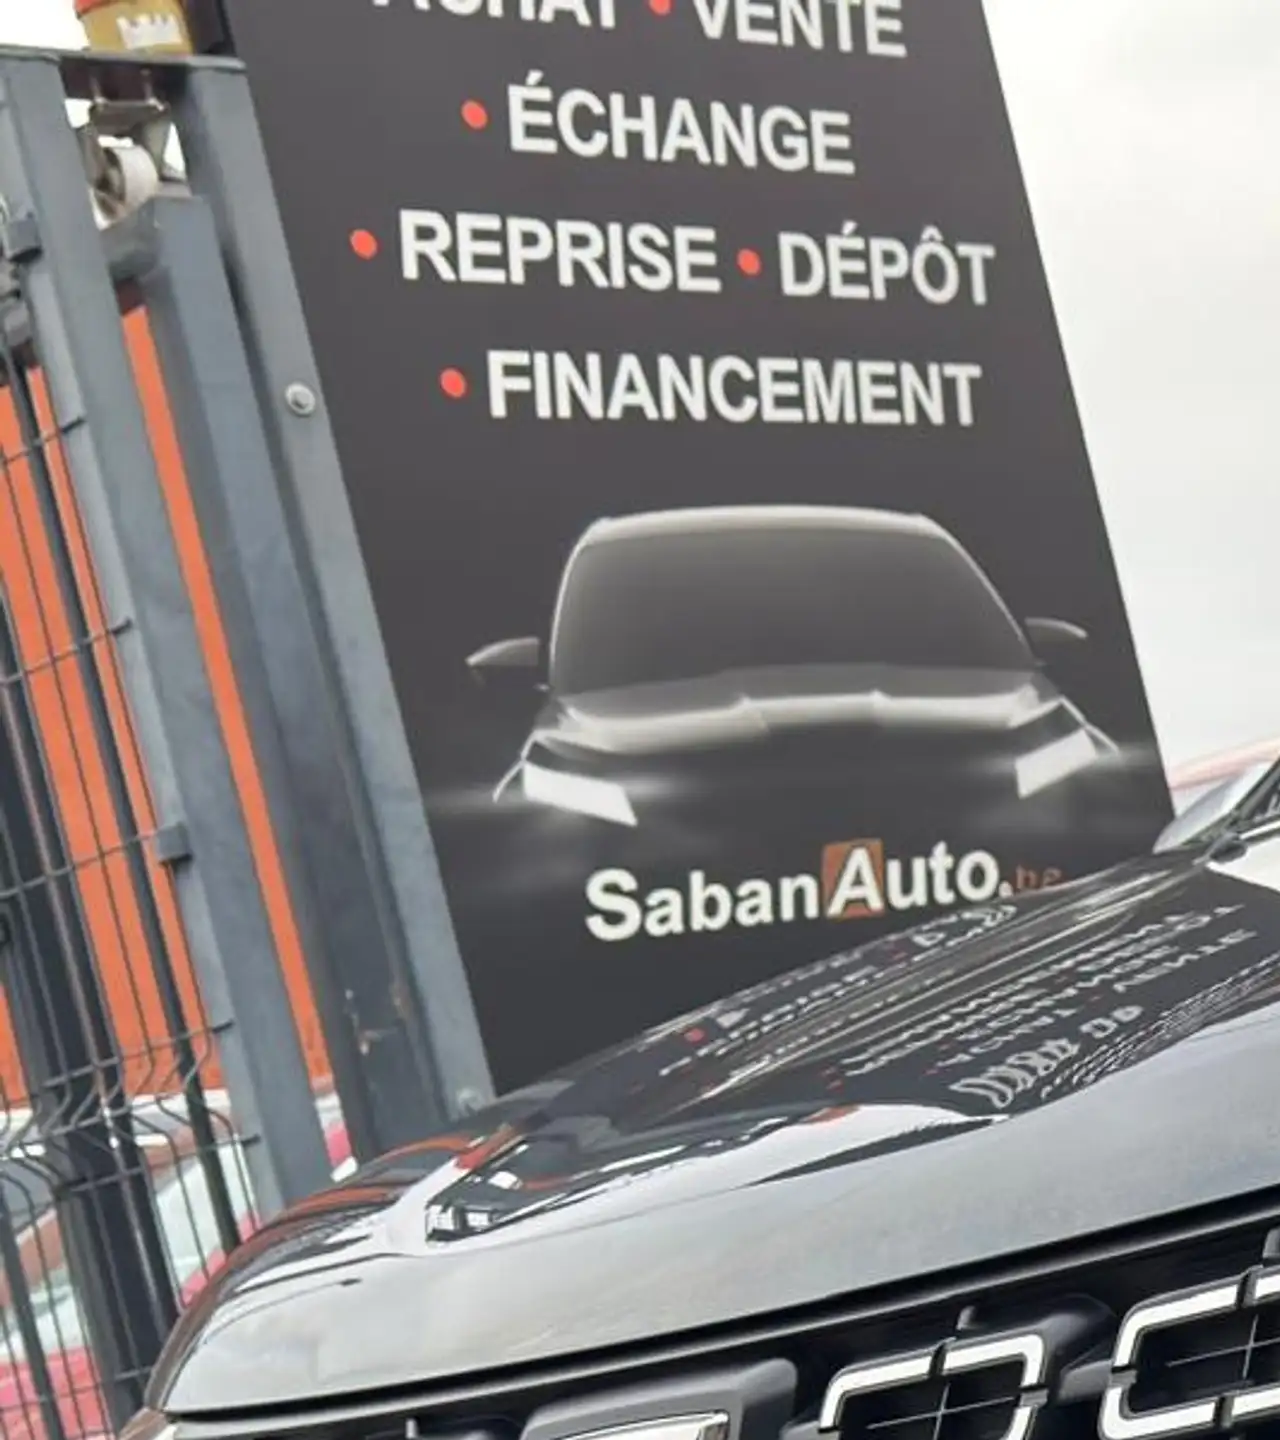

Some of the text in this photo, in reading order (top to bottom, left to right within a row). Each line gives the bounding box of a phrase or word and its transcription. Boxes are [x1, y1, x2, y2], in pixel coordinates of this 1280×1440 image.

[693, 0, 908, 58] VENTE
[506, 71, 856, 175] ÉCHANGE
[399, 209, 996, 306] REPRISE DÉPÔT
[486, 348, 983, 427] FINANCEMENT
